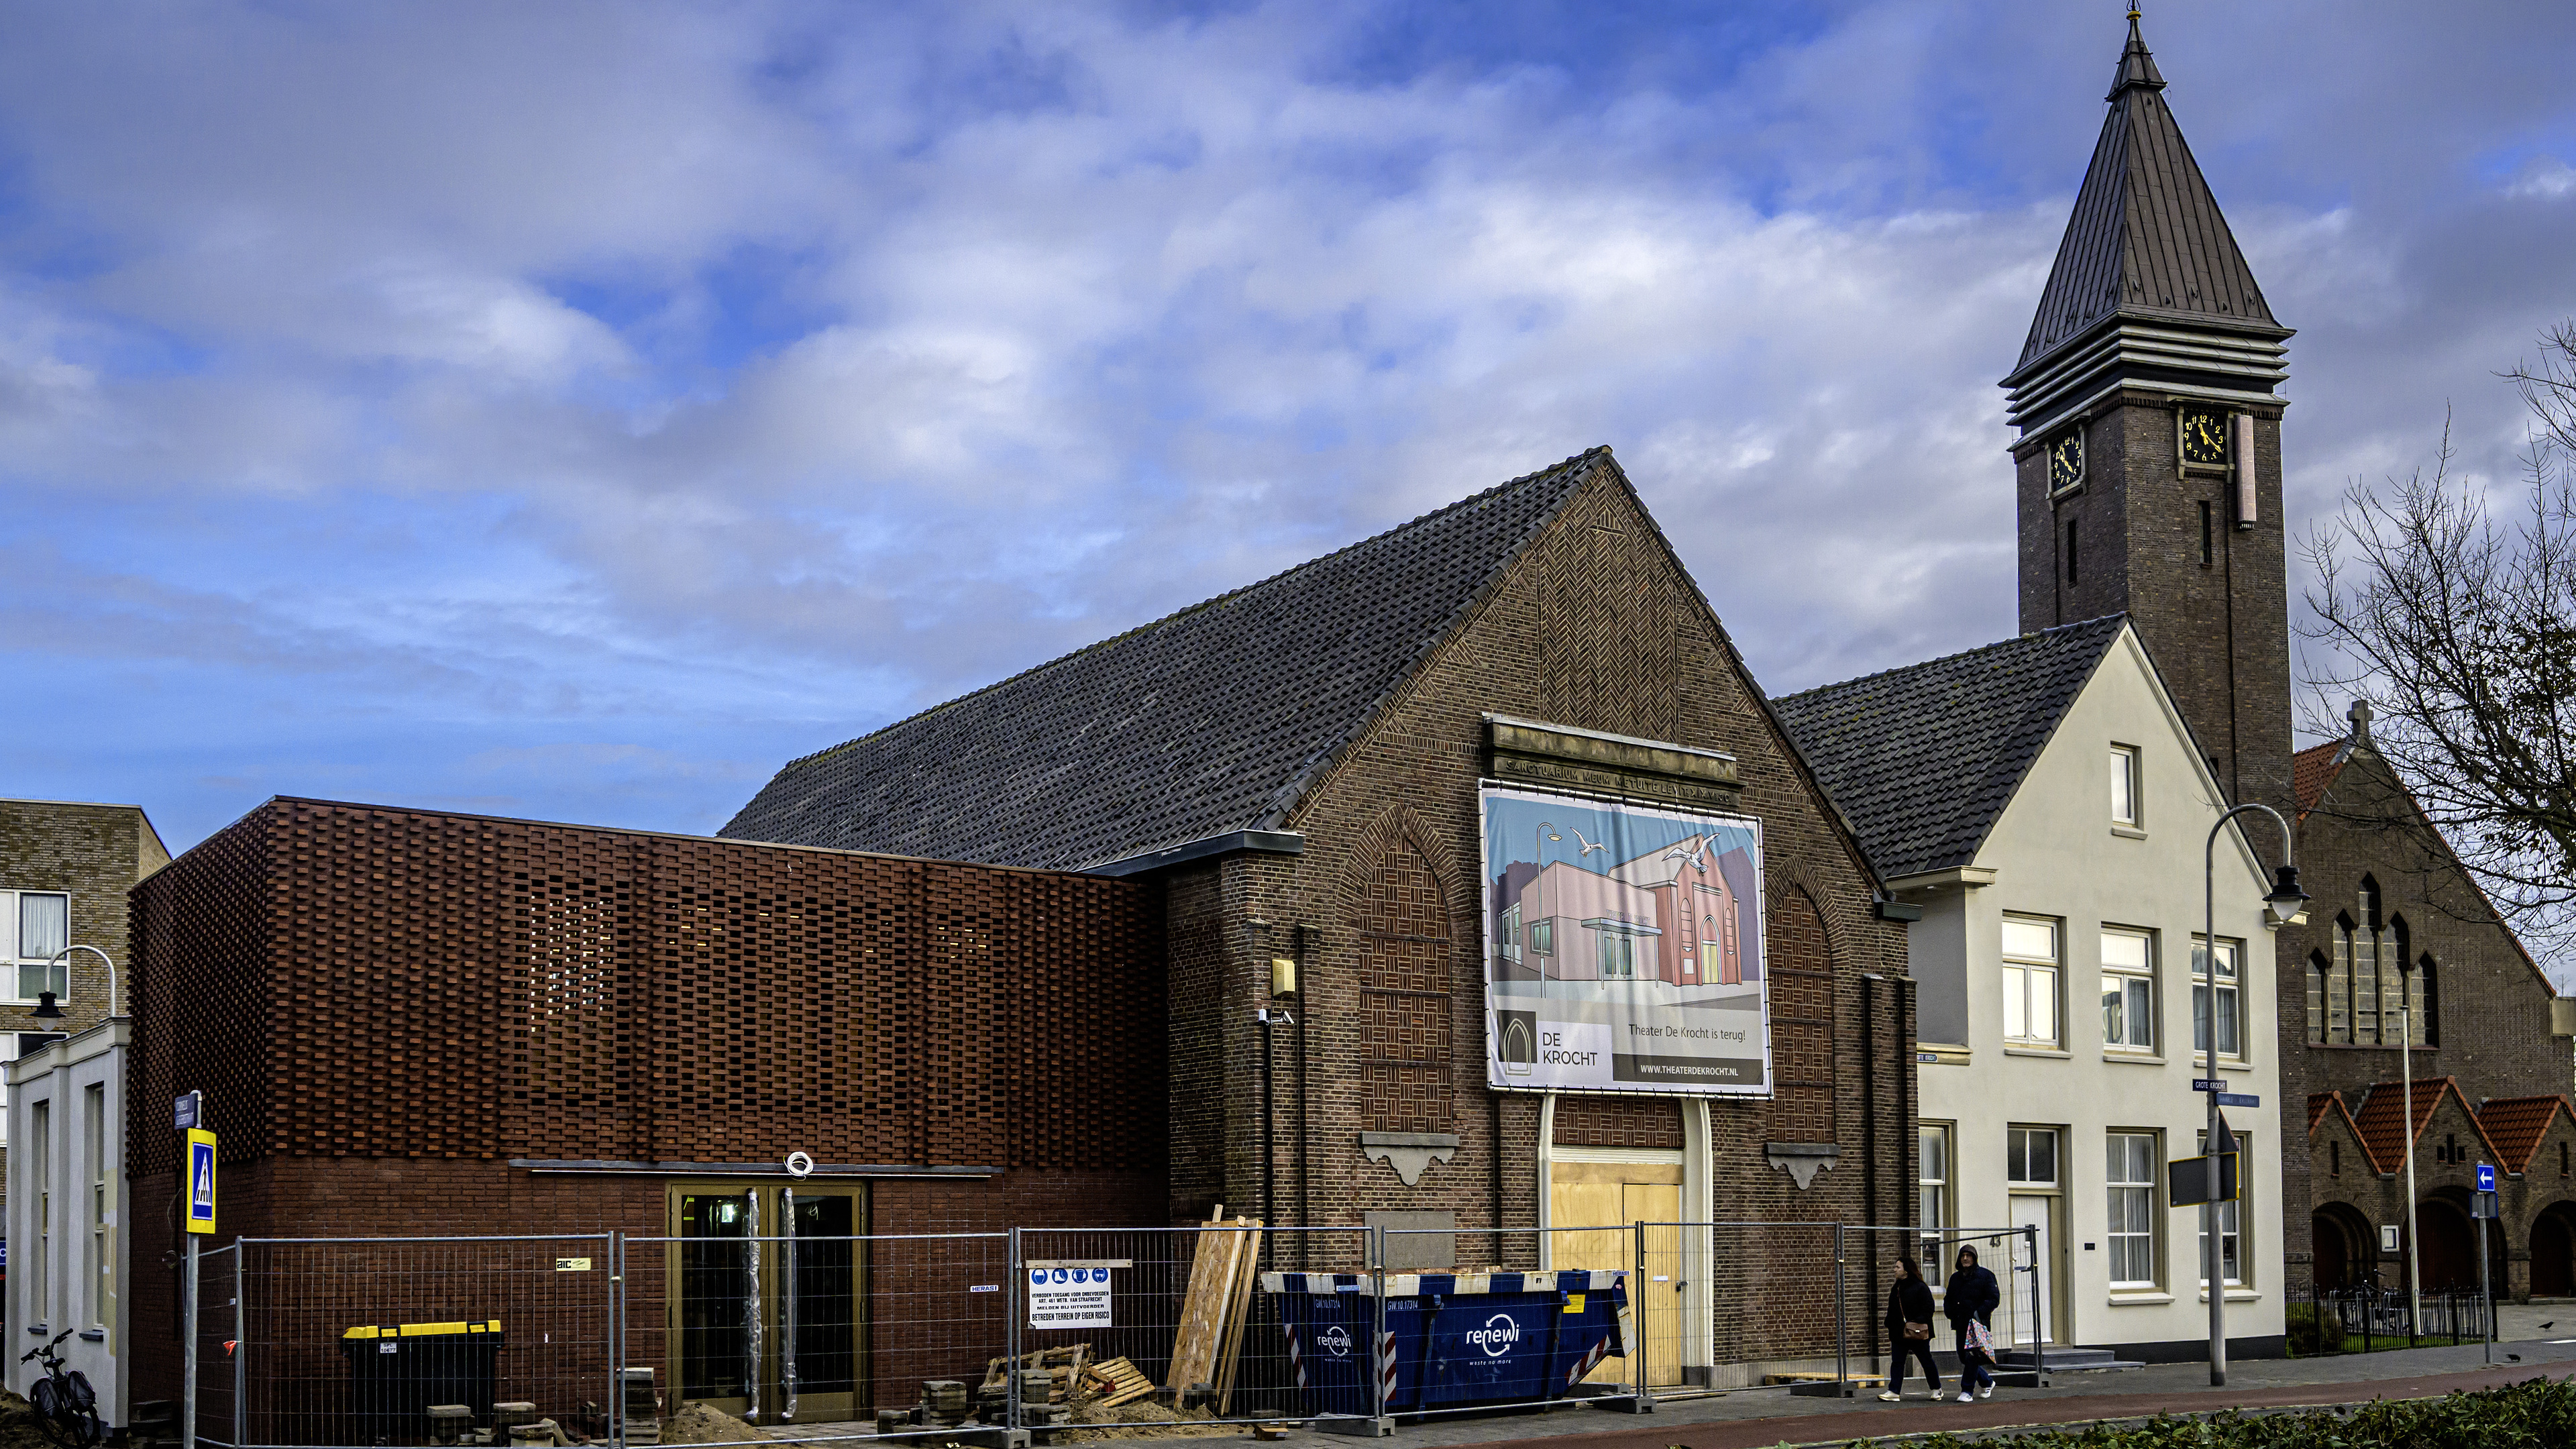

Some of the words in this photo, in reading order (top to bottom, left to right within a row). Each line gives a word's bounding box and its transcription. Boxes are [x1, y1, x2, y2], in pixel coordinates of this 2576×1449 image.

[2192, 416, 2196, 425] 11
[2200, 415, 2207, 423] 12
[2186, 422, 2192, 431] 10
[2214, 425, 2220, 433] 2
[2184, 431, 2189, 441] 9
[2218, 435, 2223, 443] 3
[2186, 442, 2192, 450] 8
[2202, 453, 2207, 461] 6
[1506, 760, 1578, 780] SANCTUARIUM
[1583, 771, 1610, 785] MEUM
[1615, 776, 1657, 792] METUITE
[1629, 1024, 1662, 1037] Theater
[1666, 1026, 1678, 1037] De
[1680, 1027, 1709, 1039] Krocht
[1711, 1028, 1718, 1039] is
[1720, 1030, 1746, 1043] terug!
[1543, 1032, 1561, 1046] DE
[1543, 1051, 1597, 1066] KROCHT
[1640, 1065, 1739, 1076] WWW.THEATERDEKROCHT.NL
[1990, 1236, 2001, 1247] 43
[1387, 1300, 1417, 1310] GW.10.17314
[1032, 1313, 1055, 1321] BETREDEN
[1095, 1311, 1110, 1319] RISICO
[1466, 1324, 1519, 1344] renewi
